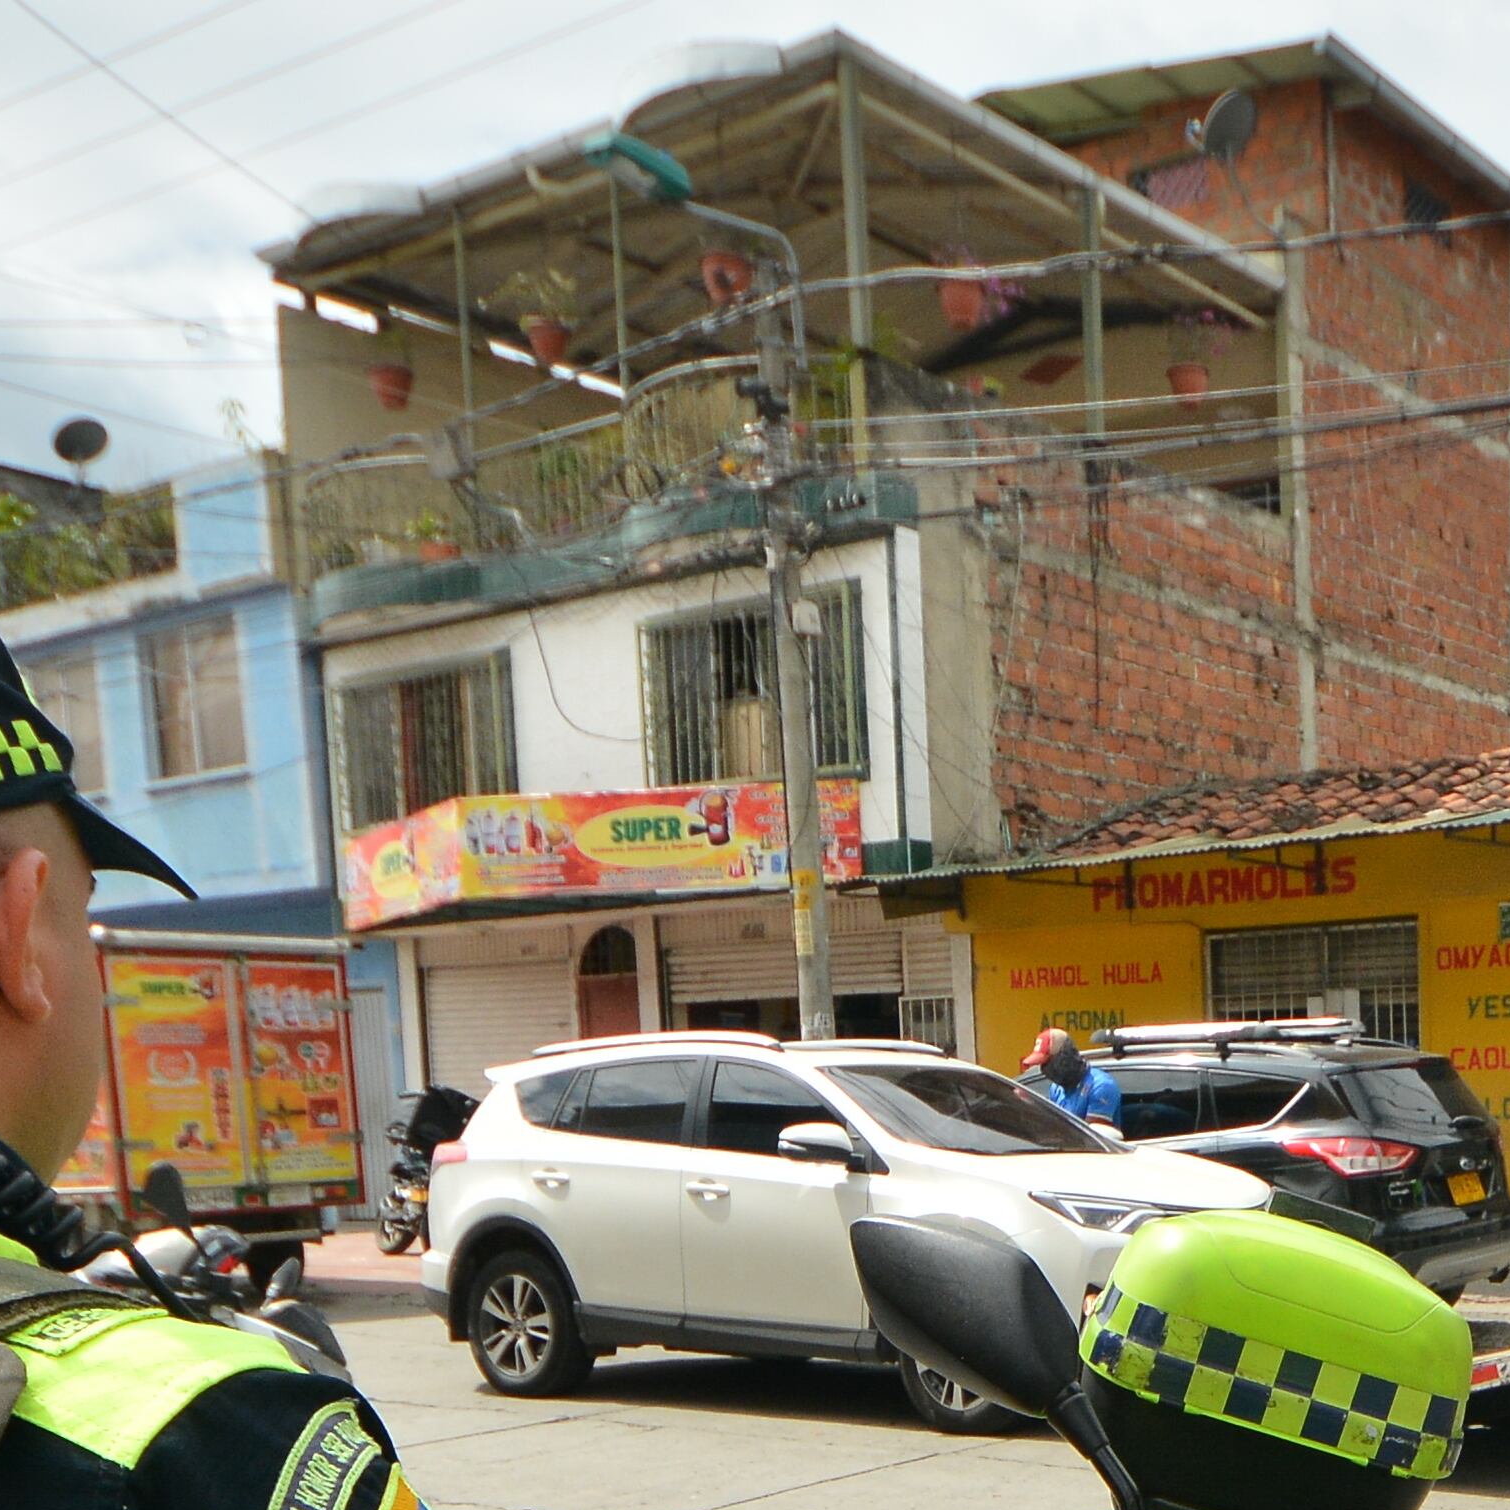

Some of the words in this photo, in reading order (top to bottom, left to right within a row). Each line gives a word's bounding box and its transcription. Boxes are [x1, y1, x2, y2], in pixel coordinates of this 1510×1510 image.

[610, 817, 682, 844] SUPER
[1011, 965, 1088, 990] MARMOL
[1103, 961, 1163, 985] HUILA
